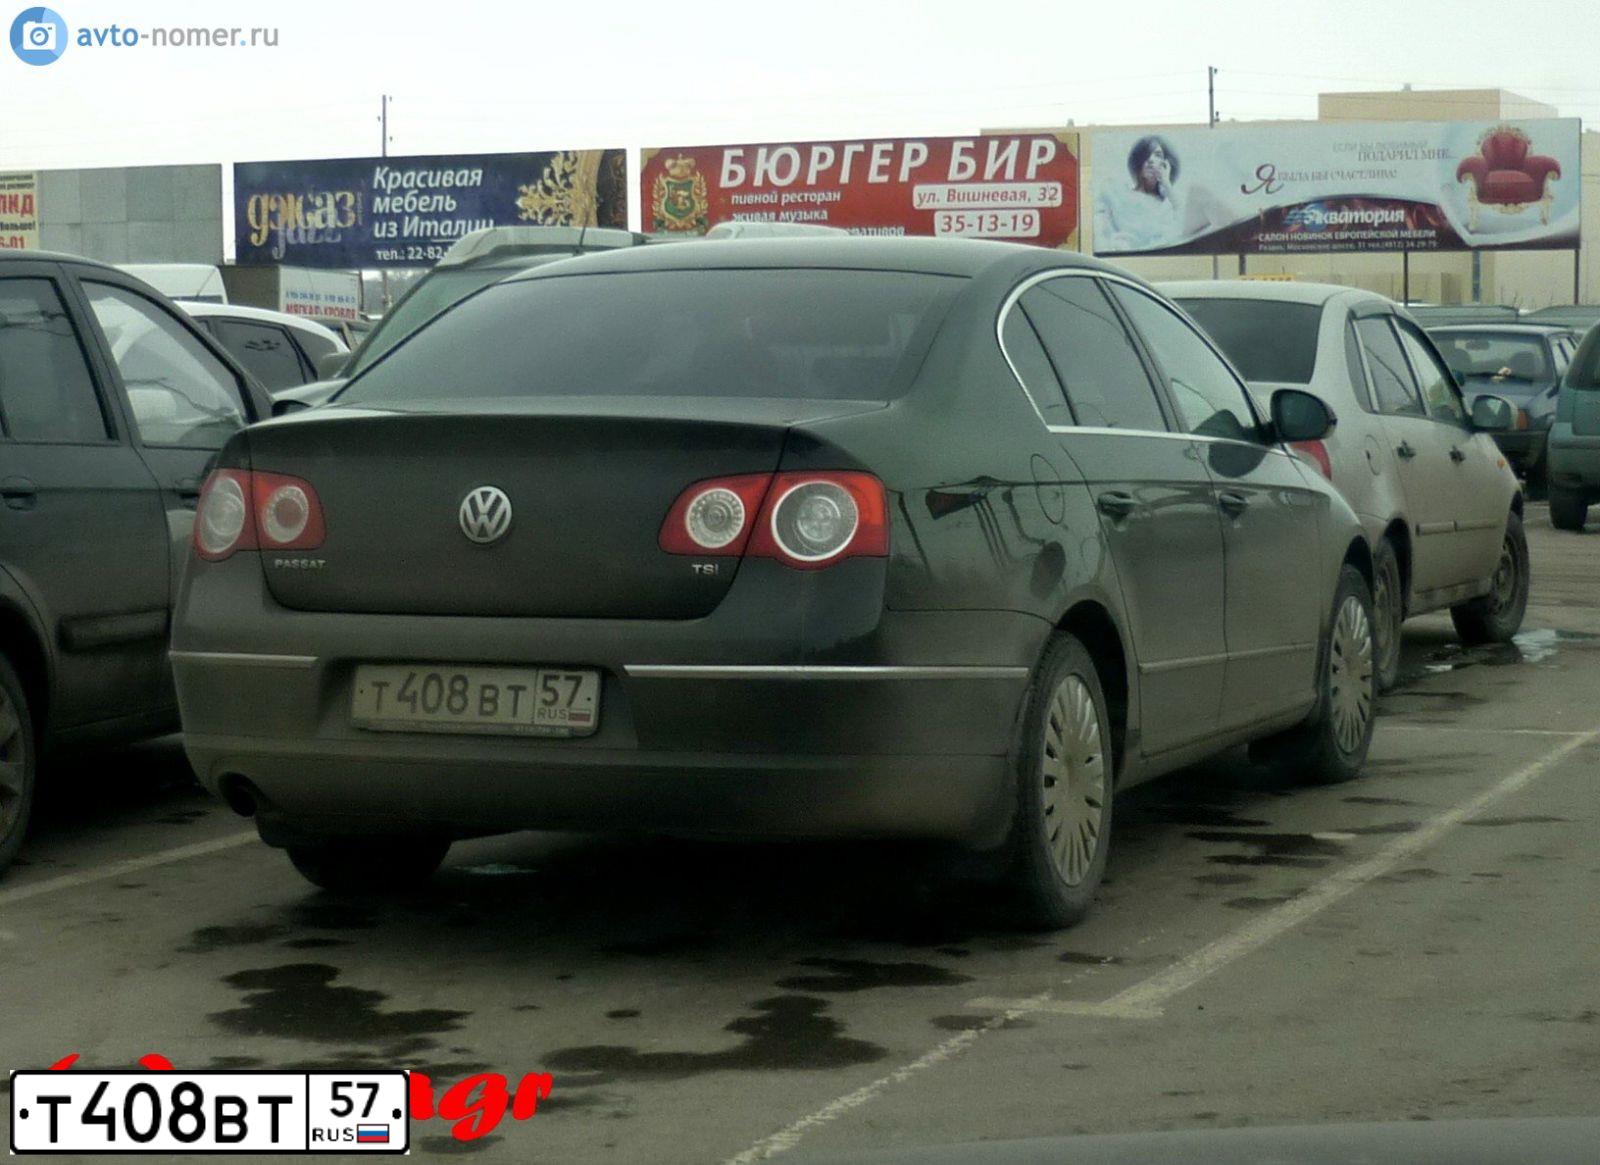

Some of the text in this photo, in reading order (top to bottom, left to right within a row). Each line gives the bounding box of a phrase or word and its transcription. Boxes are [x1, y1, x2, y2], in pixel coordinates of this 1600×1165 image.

[719, 138, 1056, 188] БЮРГЕР БИР
[373, 166, 483, 194] Красивая
[373, 189, 457, 214] мебель
[731, 189, 841, 206] пивной ресторан
[917, 191, 940, 207] ул.
[1038, 186, 1058, 201] 32
[779, 208, 828, 224] музыка
[941, 214, 1034, 233] 35-13-19
[374, 221, 398, 238] из
[274, 558, 326, 569] PASSAT
[541, 674, 583, 709] 57
[537, 708, 568, 720] RUS
